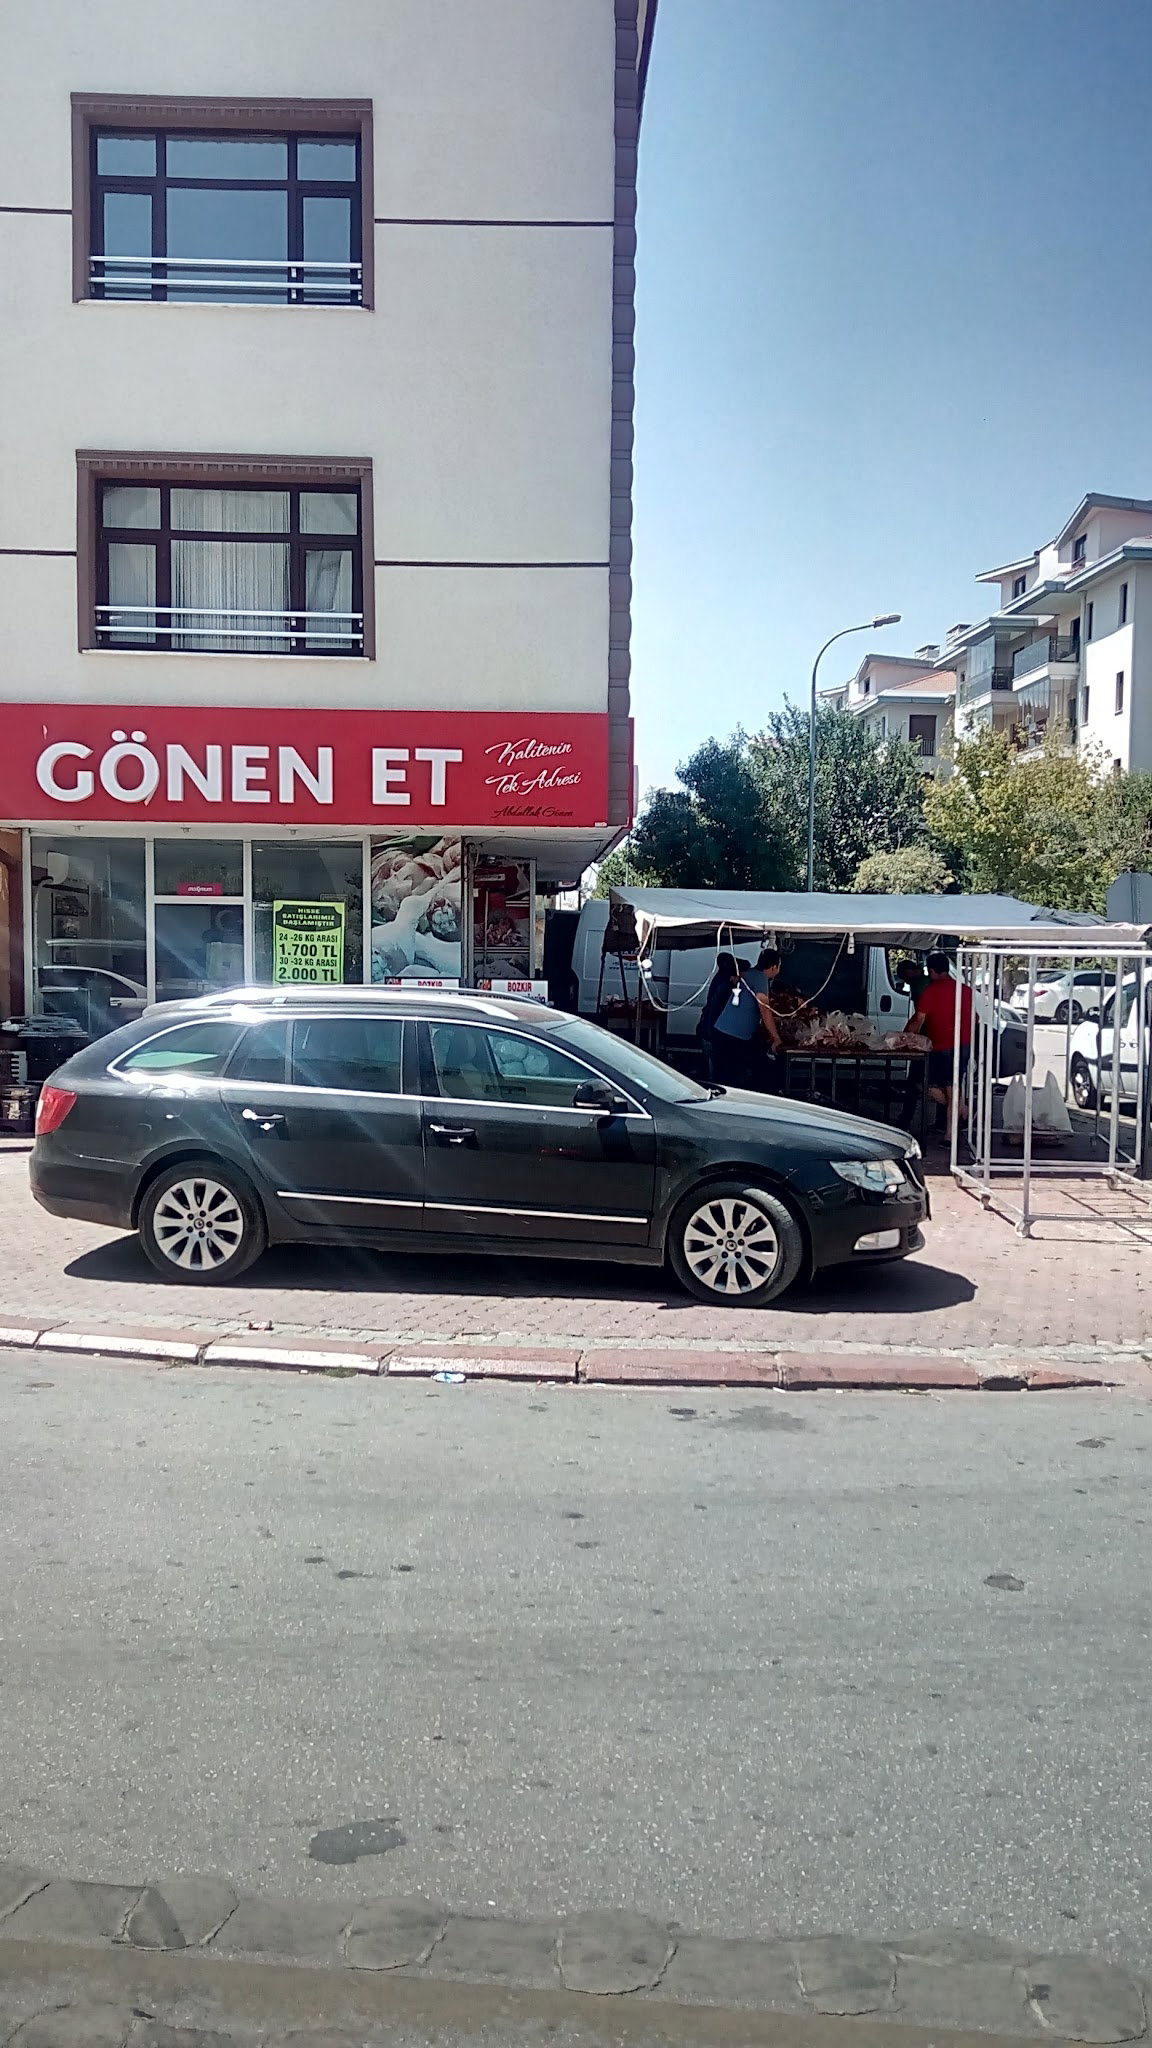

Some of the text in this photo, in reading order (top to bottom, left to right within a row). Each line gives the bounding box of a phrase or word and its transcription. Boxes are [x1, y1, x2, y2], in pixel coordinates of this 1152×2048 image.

[484, 738, 572, 766] Kalitenin
[36, 730, 463, 806] GÖNEN ET
[484, 766, 581, 795] Tek Adresi
[279, 933, 288, 941] 24
[305, 934, 315, 942] KG
[316, 934, 338, 943] ARASI
[279, 943, 338, 958] 1.700 TL
[279, 957, 289, 965] 30
[304, 958, 314, 966] KG
[316, 958, 337, 967] ARASI
[278, 966, 338, 982] 2.000 TL
[507, 981, 533, 992] BOZKIR
